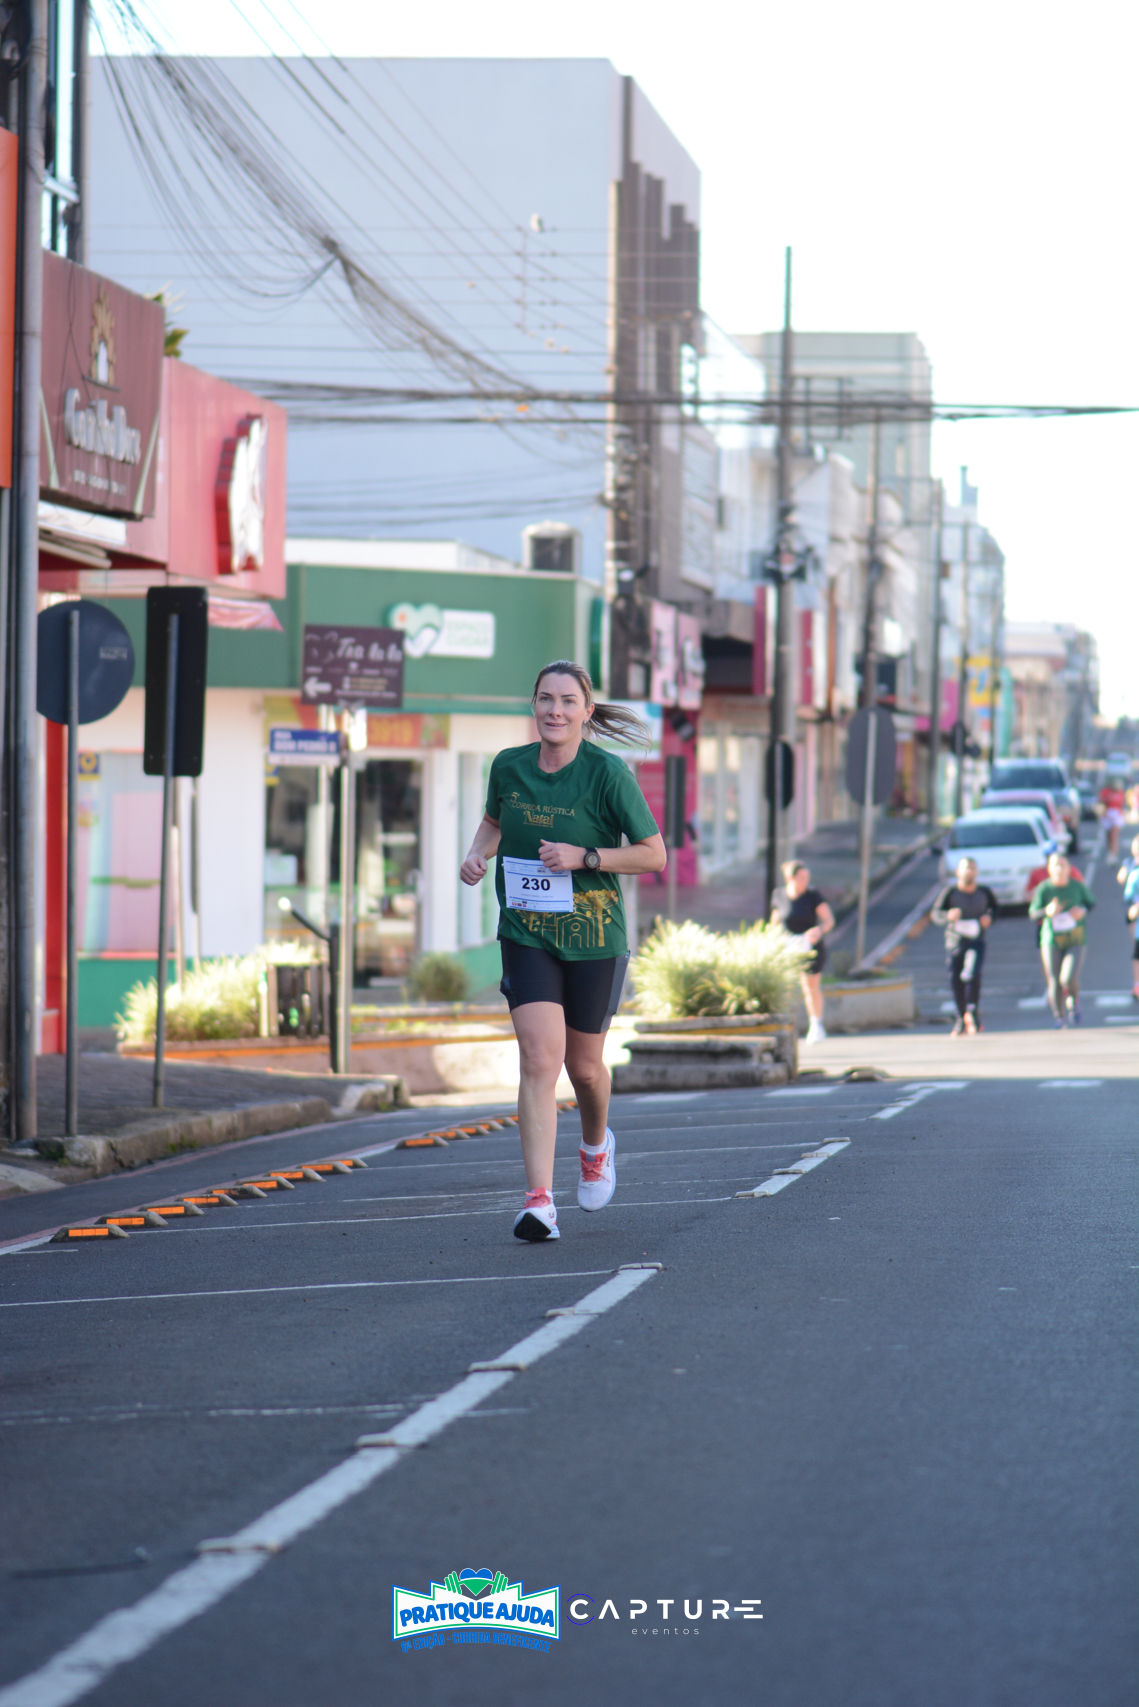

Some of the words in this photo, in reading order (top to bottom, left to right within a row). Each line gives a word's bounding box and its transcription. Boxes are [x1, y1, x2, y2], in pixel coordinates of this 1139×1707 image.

[512, 801, 541, 812] CORRIDA
[542, 804, 575, 817] RÚSTICA
[523, 810, 554, 826] Natal
[521, 877, 551, 891] 230
